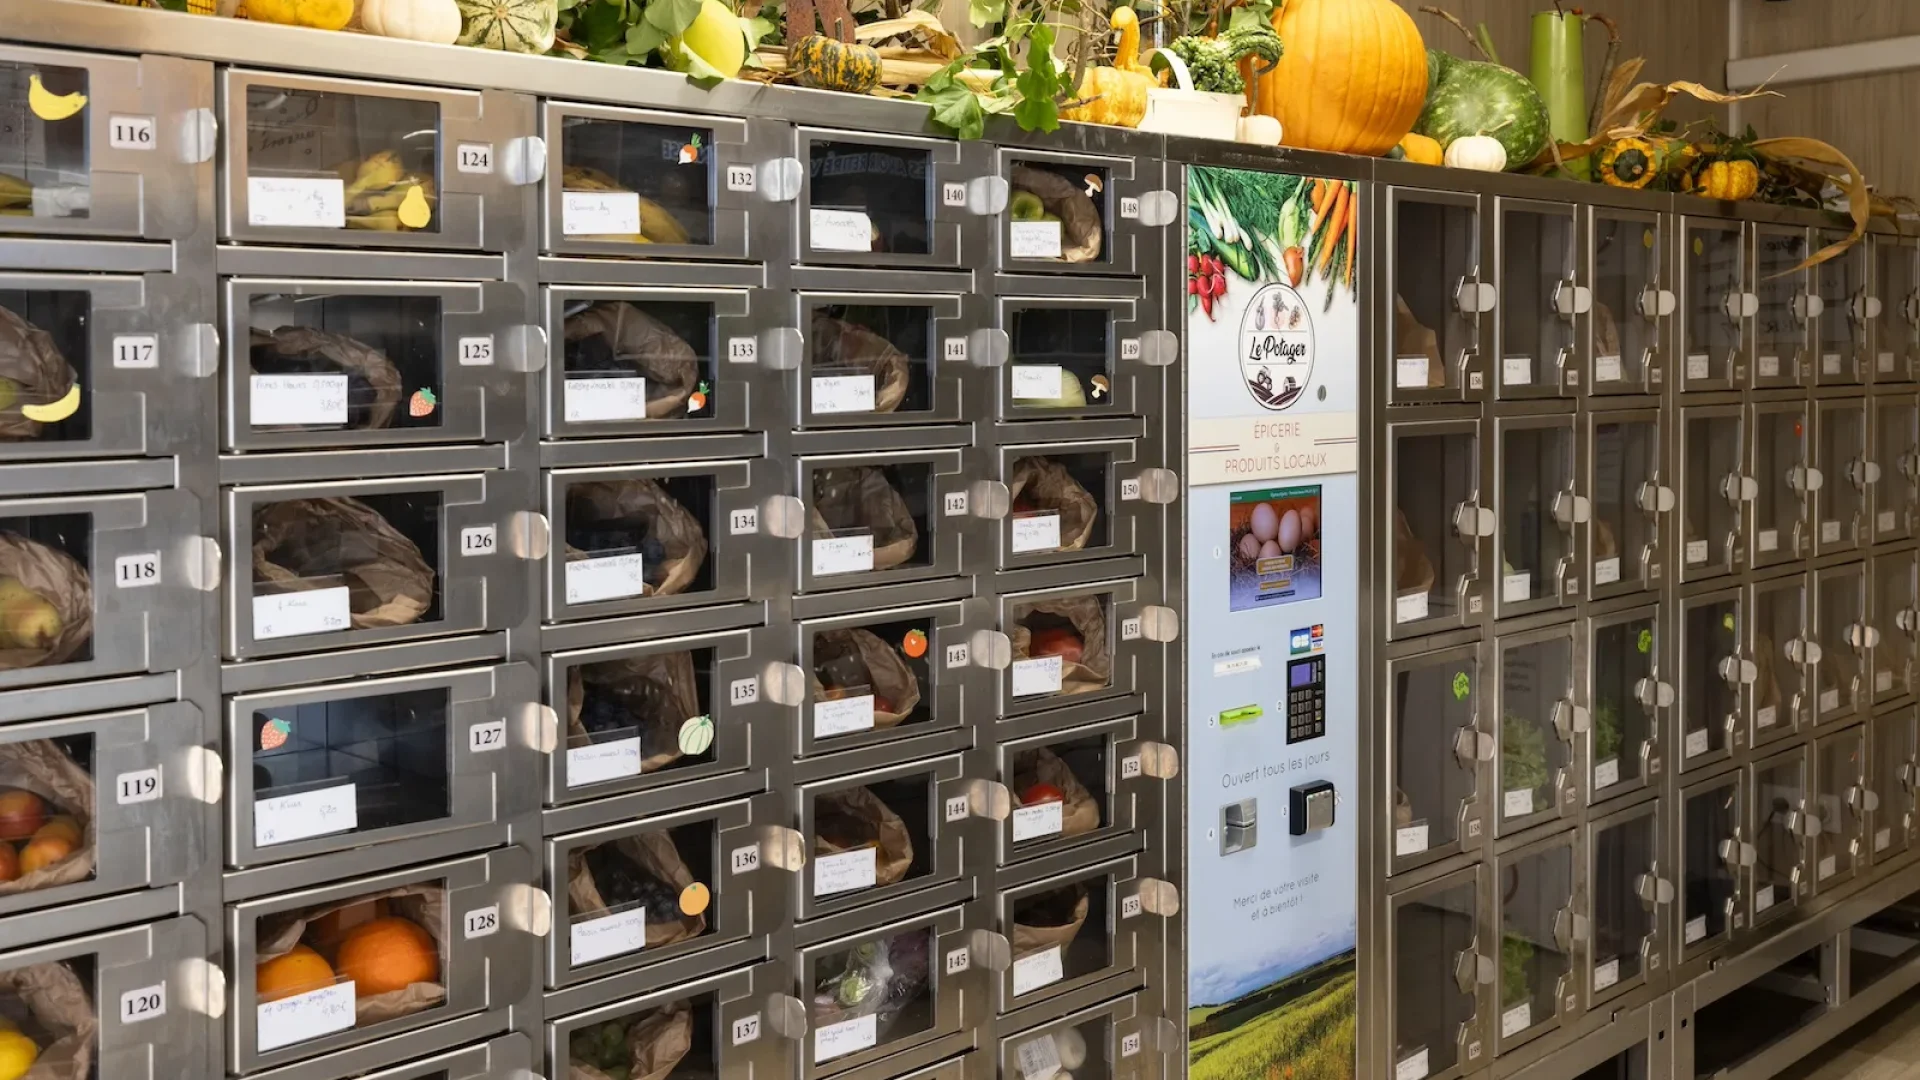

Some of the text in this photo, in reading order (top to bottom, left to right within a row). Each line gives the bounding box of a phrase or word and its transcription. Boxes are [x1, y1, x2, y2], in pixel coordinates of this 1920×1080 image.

[116, 125, 150, 143] 116
[462, 151, 488, 167] 124
[731, 172, 752, 186] 132
[946, 188, 964, 201] 140
[1122, 201, 1137, 214] 148
[120, 344, 153, 361] 117
[464, 343, 490, 359] 125
[732, 343, 754, 356] 133
[948, 343, 964, 356] 141
[1123, 342, 1138, 355] 149
[1249, 335, 1306, 365] Le Potager
[1254, 420, 1300, 439] ÉPICERIE
[1225, 452, 1327, 473] PRODUITS LOCAUX
[1123, 483, 1138, 496] 150
[947, 497, 965, 511] 142
[733, 515, 755, 529] 134
[466, 533, 492, 549] 126
[122, 561, 156, 581] 118
[1124, 622, 1138, 636] 151
[948, 649, 966, 663] 143
[733, 684, 755, 699] 135
[474, 728, 501, 745] 127
[1123, 760, 1138, 774] 152
[1222, 751, 1331, 788] Ouvert tous les jours
[123, 776, 156, 798] 119
[948, 801, 965, 817] 144
[735, 851, 757, 868] 136
[1233, 873, 1320, 909] Merci de votre visite
[1124, 899, 1138, 913] 153
[1250, 908, 1260, 921] et
[1261, 906, 1269, 917] à
[1270, 897, 1299, 915] bientôt
[469, 913, 496, 932] 128
[949, 953, 966, 970] 145
[127, 993, 161, 1016] 120
[736, 1020, 757, 1039] 137
